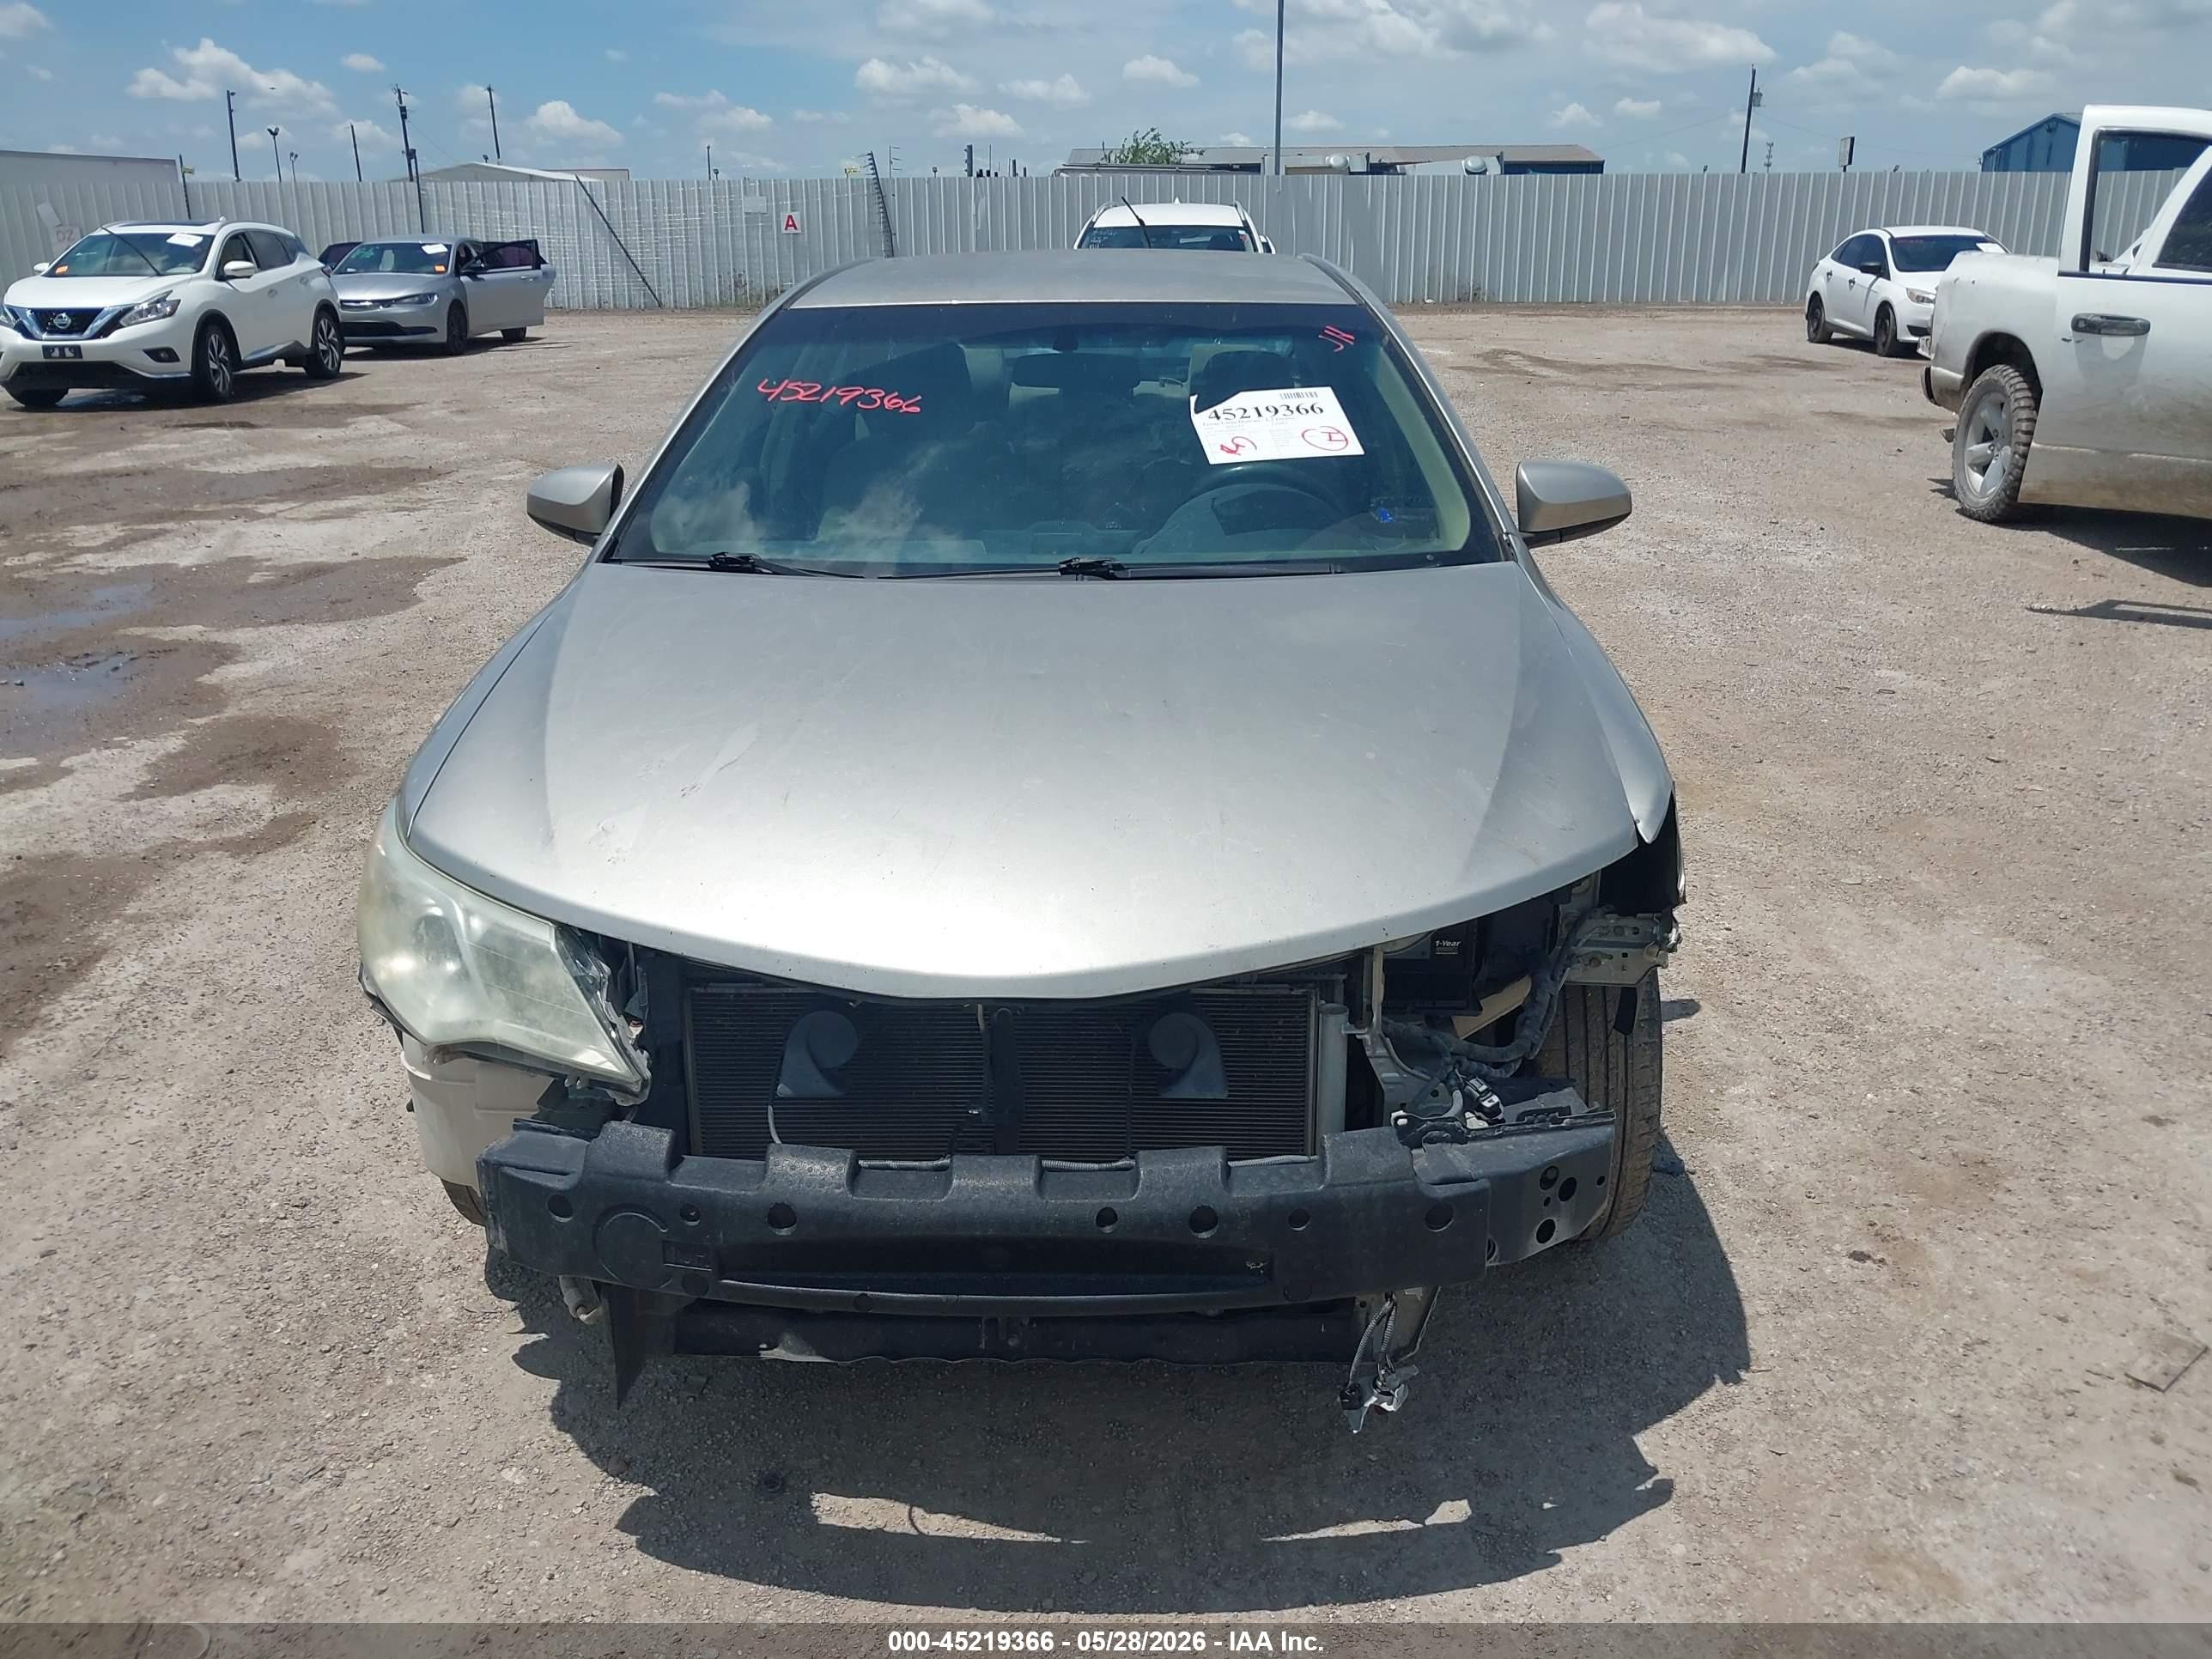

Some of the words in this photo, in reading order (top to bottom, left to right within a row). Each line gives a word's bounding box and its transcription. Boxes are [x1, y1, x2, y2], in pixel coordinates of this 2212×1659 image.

[785, 214, 798, 231] A
[757, 378, 923, 413] 45219366
[1208, 402, 1324, 421] 45219366
